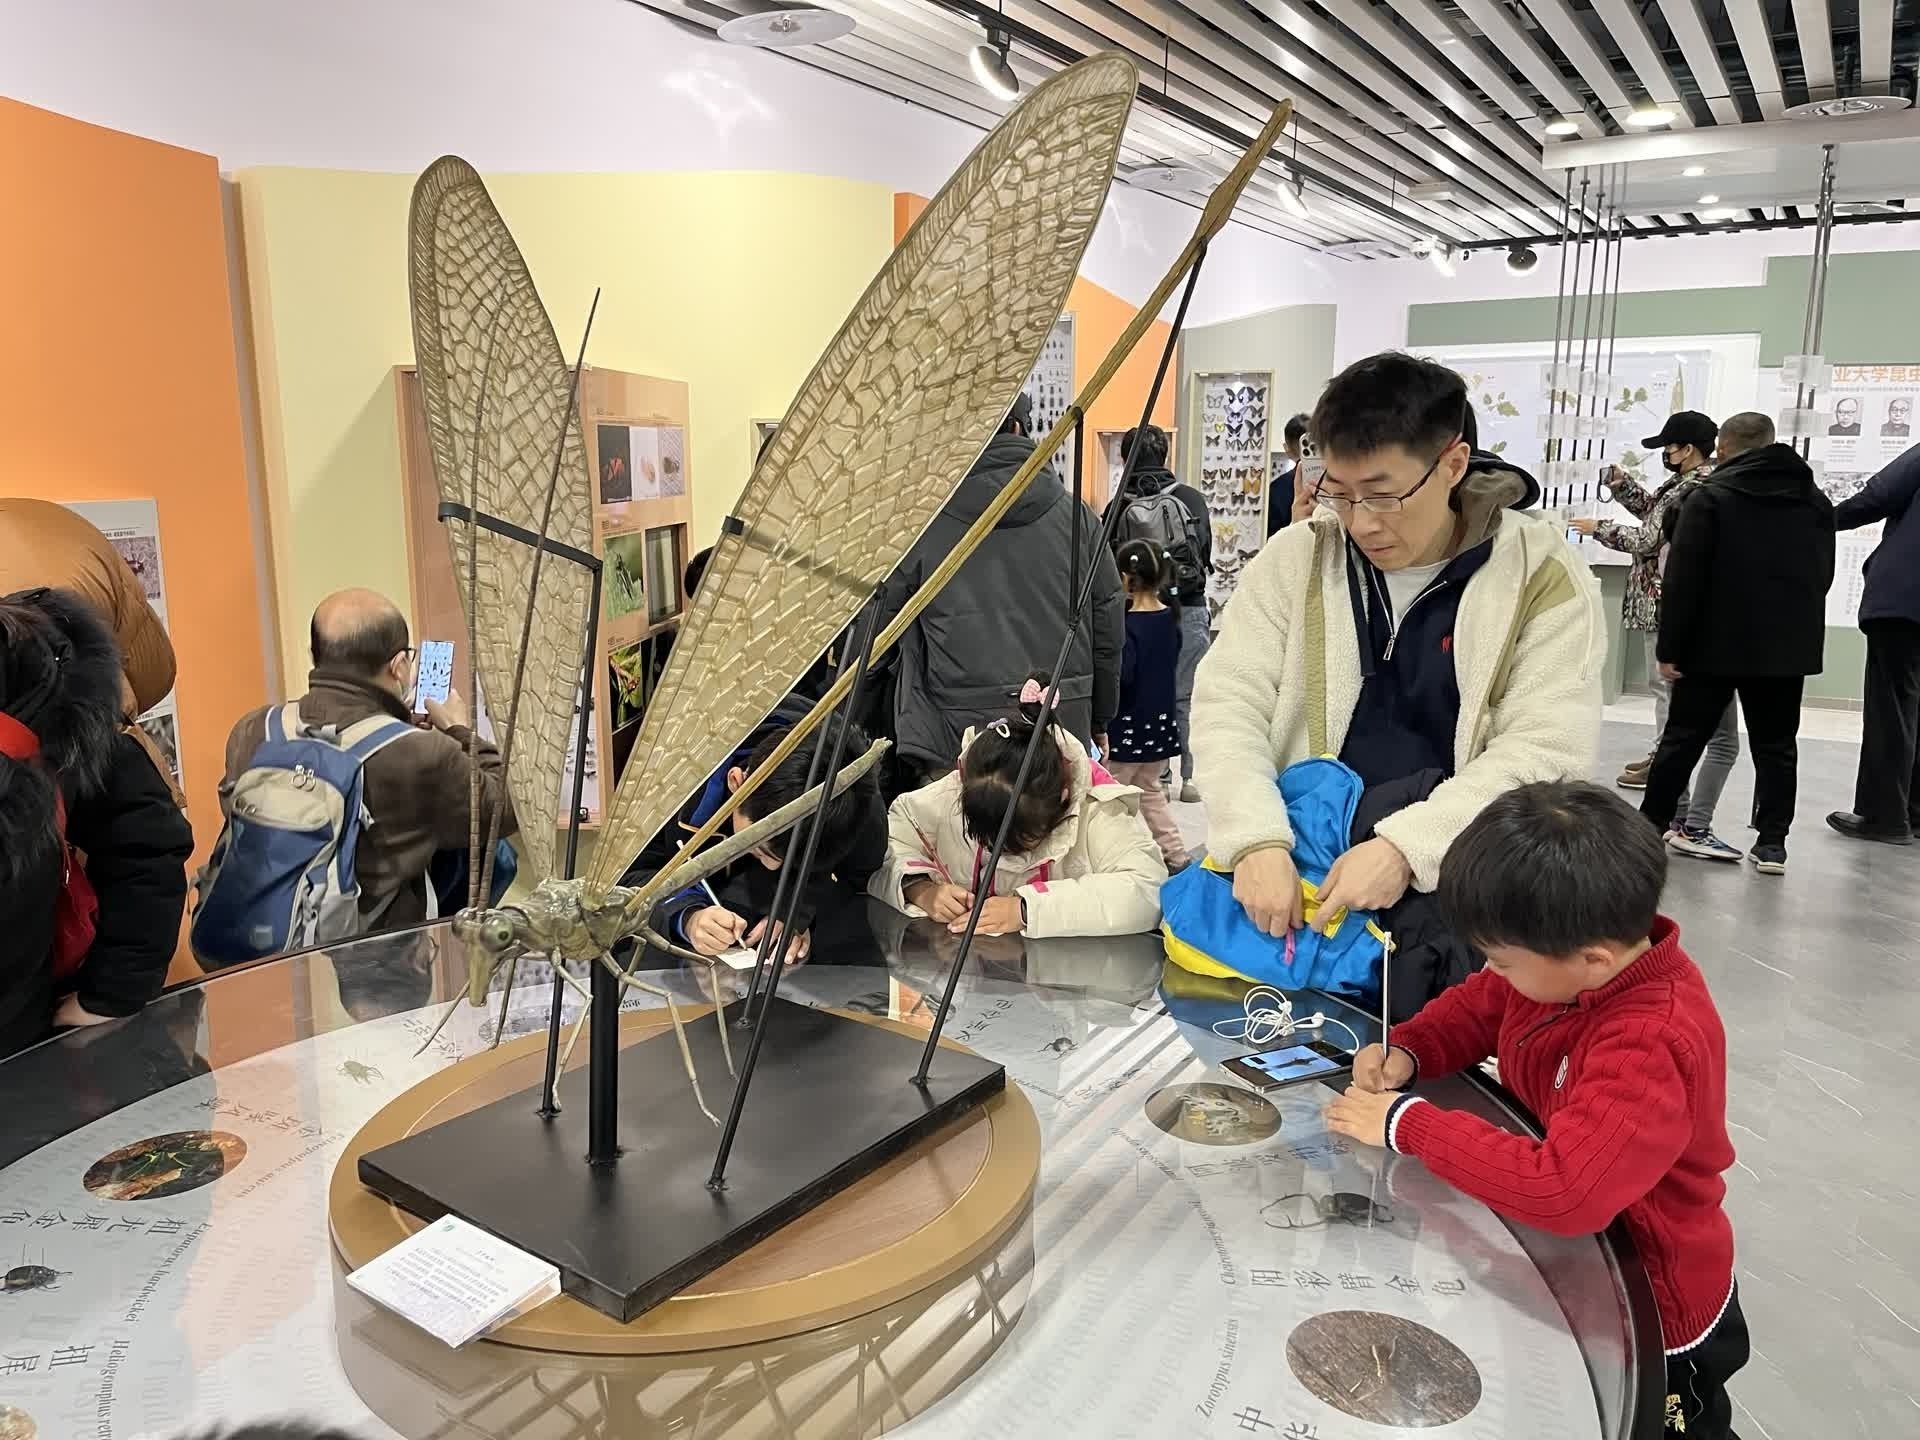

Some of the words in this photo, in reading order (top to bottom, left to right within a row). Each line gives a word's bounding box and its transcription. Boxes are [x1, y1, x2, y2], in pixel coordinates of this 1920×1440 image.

[95, 1339, 131, 1418] Heliogomphus
[1195, 1360, 1232, 1418] Zorotypus
[1219, 1318, 1239, 1361] sinensis
